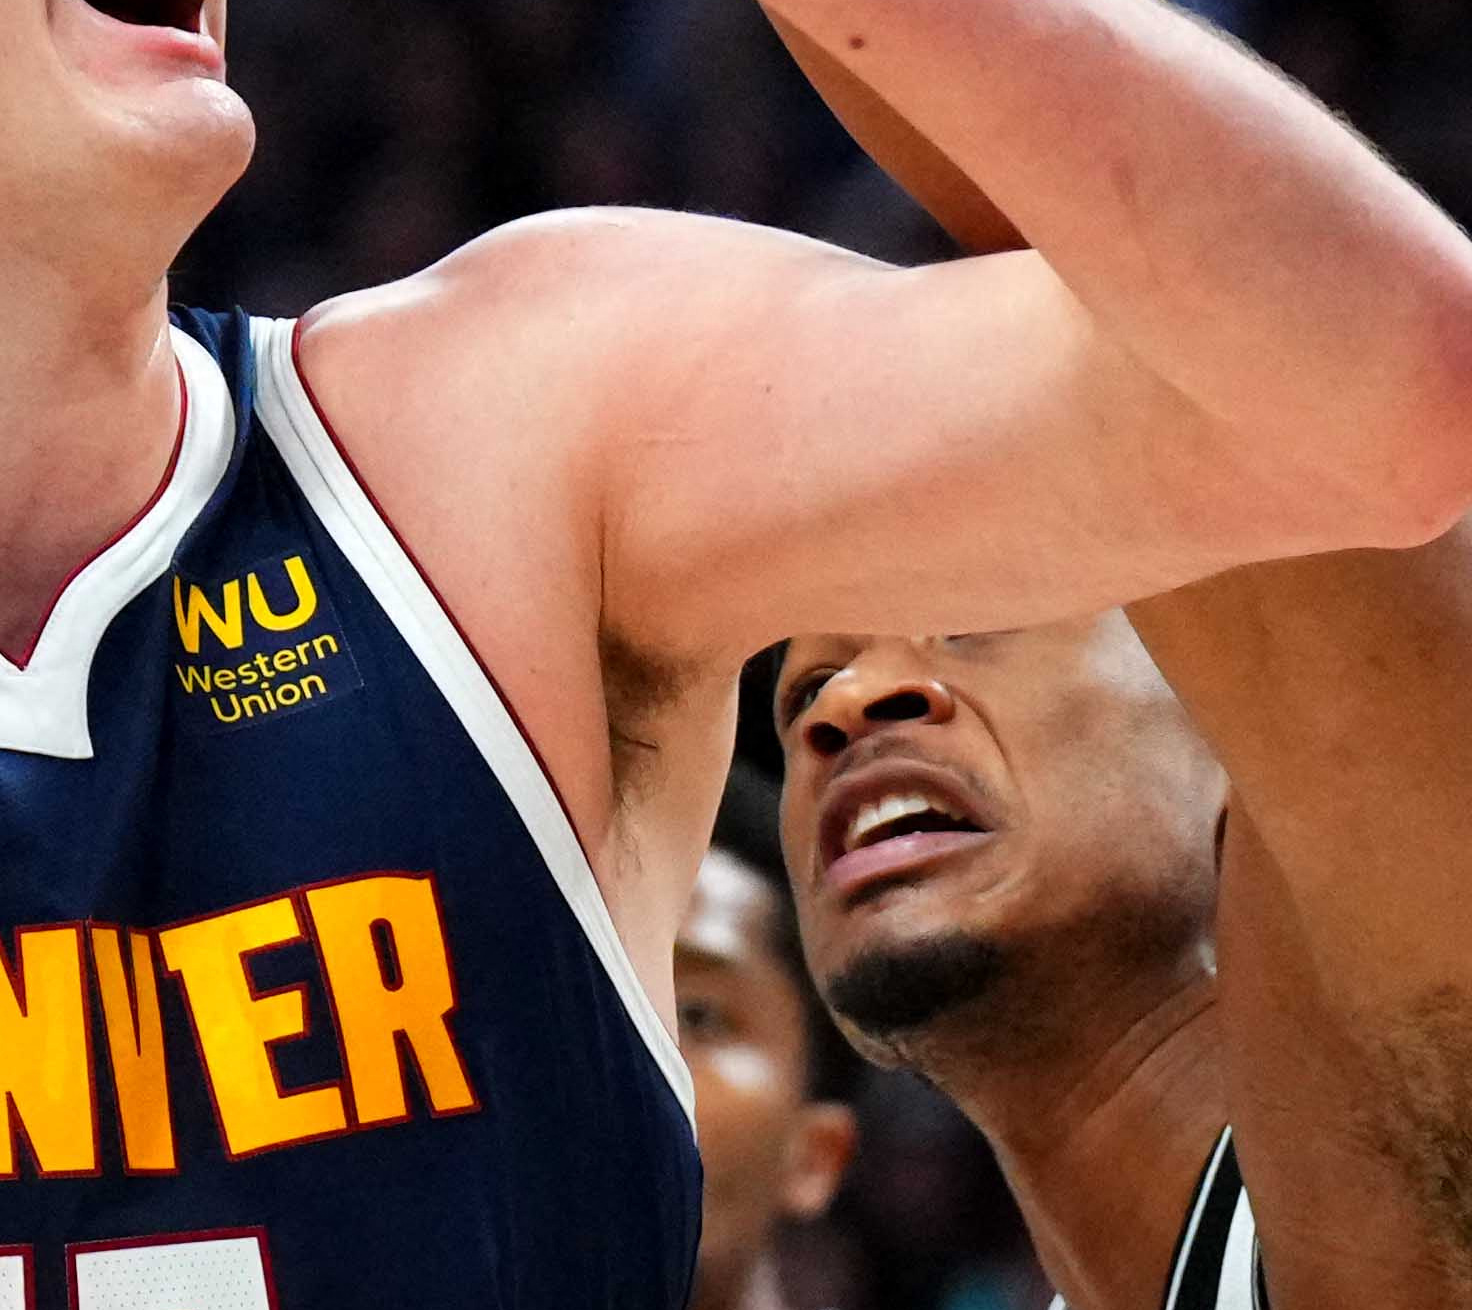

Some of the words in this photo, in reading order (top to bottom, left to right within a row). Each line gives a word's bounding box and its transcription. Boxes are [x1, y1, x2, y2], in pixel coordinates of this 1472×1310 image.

[174, 555, 317, 654] WU
[175, 634, 339, 694] Western
[210, 674, 326, 723] Union
